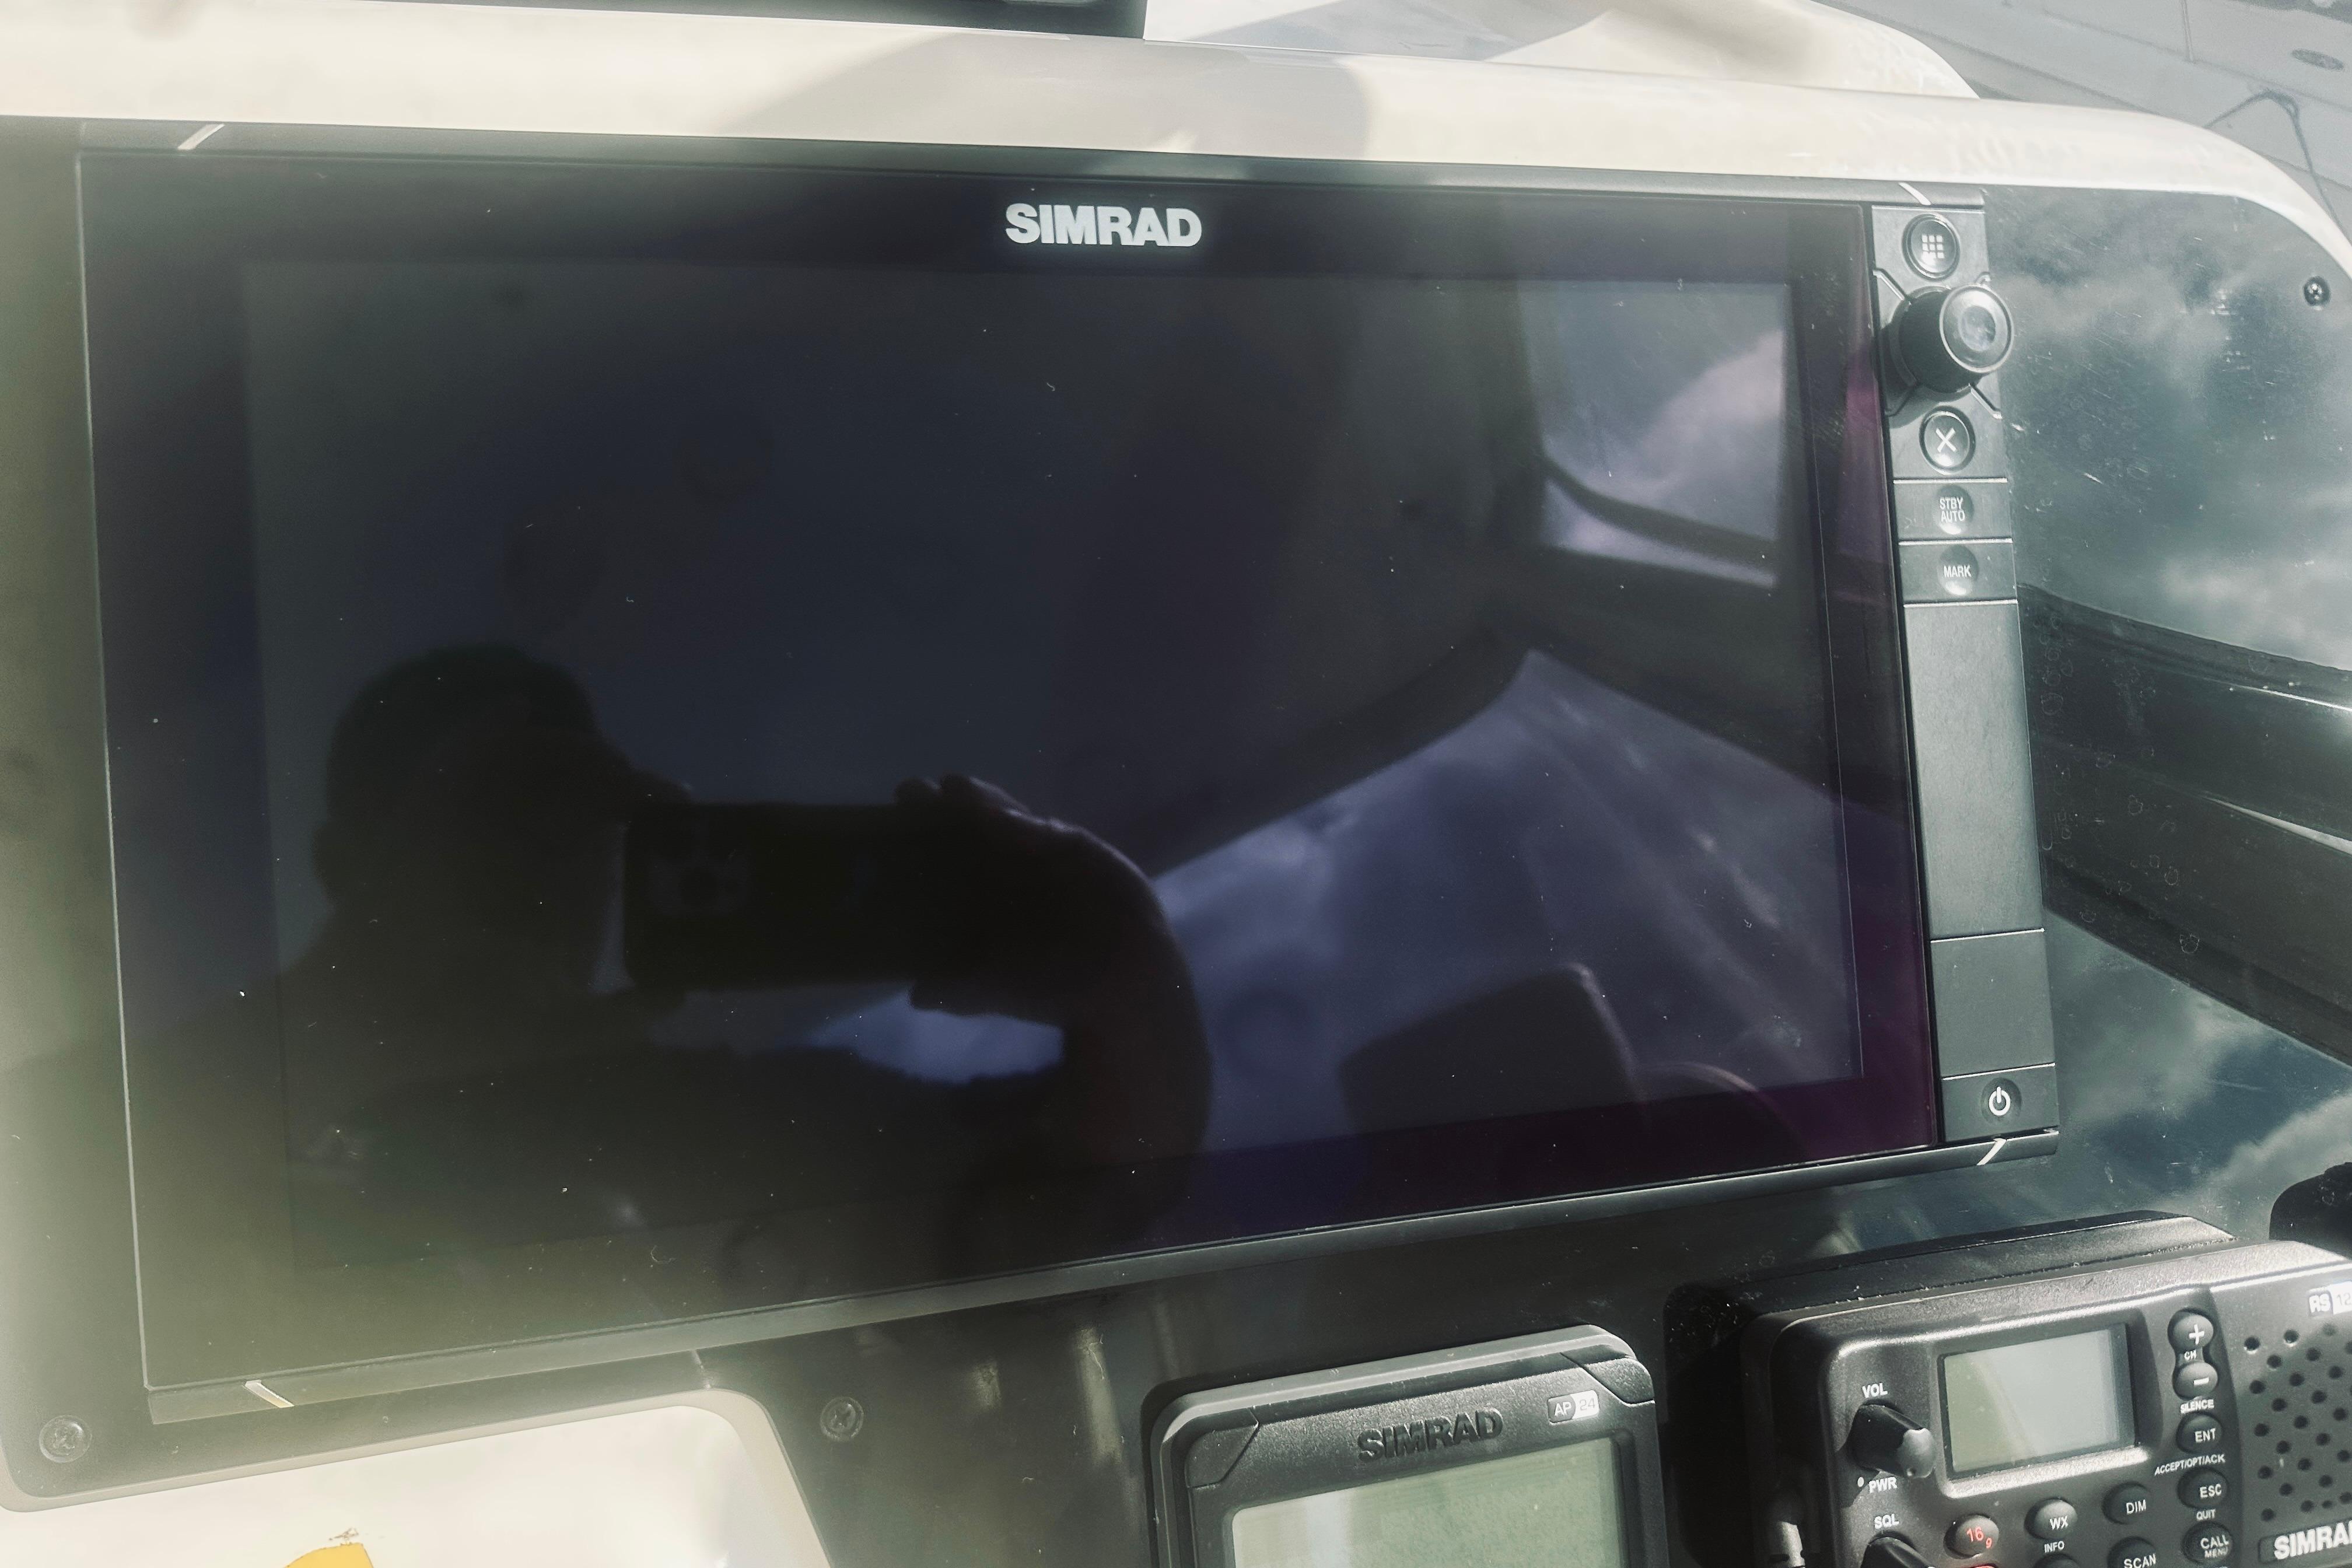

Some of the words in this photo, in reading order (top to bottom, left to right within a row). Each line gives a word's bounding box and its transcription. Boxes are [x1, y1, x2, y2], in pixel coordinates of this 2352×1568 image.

[1006, 203, 1202, 247] SIMRAD
[1939, 496, 1964, 510] STBY
[1940, 509, 1965, 523] AUTO
[1943, 564, 1972, 578] MARK
[2309, 1293, 2331, 1313] RS
[2184, 1350, 2197, 1361] CH
[1861, 1382, 1888, 1398] VOL
[1554, 1401, 1572, 1417] AP
[1579, 1398, 1595, 1411] 24
[2180, 1399, 2215, 1415] SILENCE
[1357, 1406, 1503, 1462] SIMRAD
[2194, 1427, 2216, 1443] ENT
[2154, 1453, 2226, 1476] ACCEPT/OPT/ACK
[1868, 1476, 1898, 1493] PWR
[2199, 1483, 2222, 1499] ESC
[2126, 1499, 2147, 1515] DIM
[2196, 1509, 2216, 1521] QUIT
[1874, 1513, 1899, 1530] SQL
[2049, 1516, 2068, 1530] WX
[1966, 1526, 1984, 1542] 16
[1986, 1537, 1993, 1549] 9
[2200, 1535, 2230, 1549] CALL
[2274, 1520, 2352, 1560] SIMRA
[2044, 1541, 2065, 1553] INFO
[2204, 1548, 2228, 1559] MENU
[2124, 1553, 2157, 1568] SCAN
